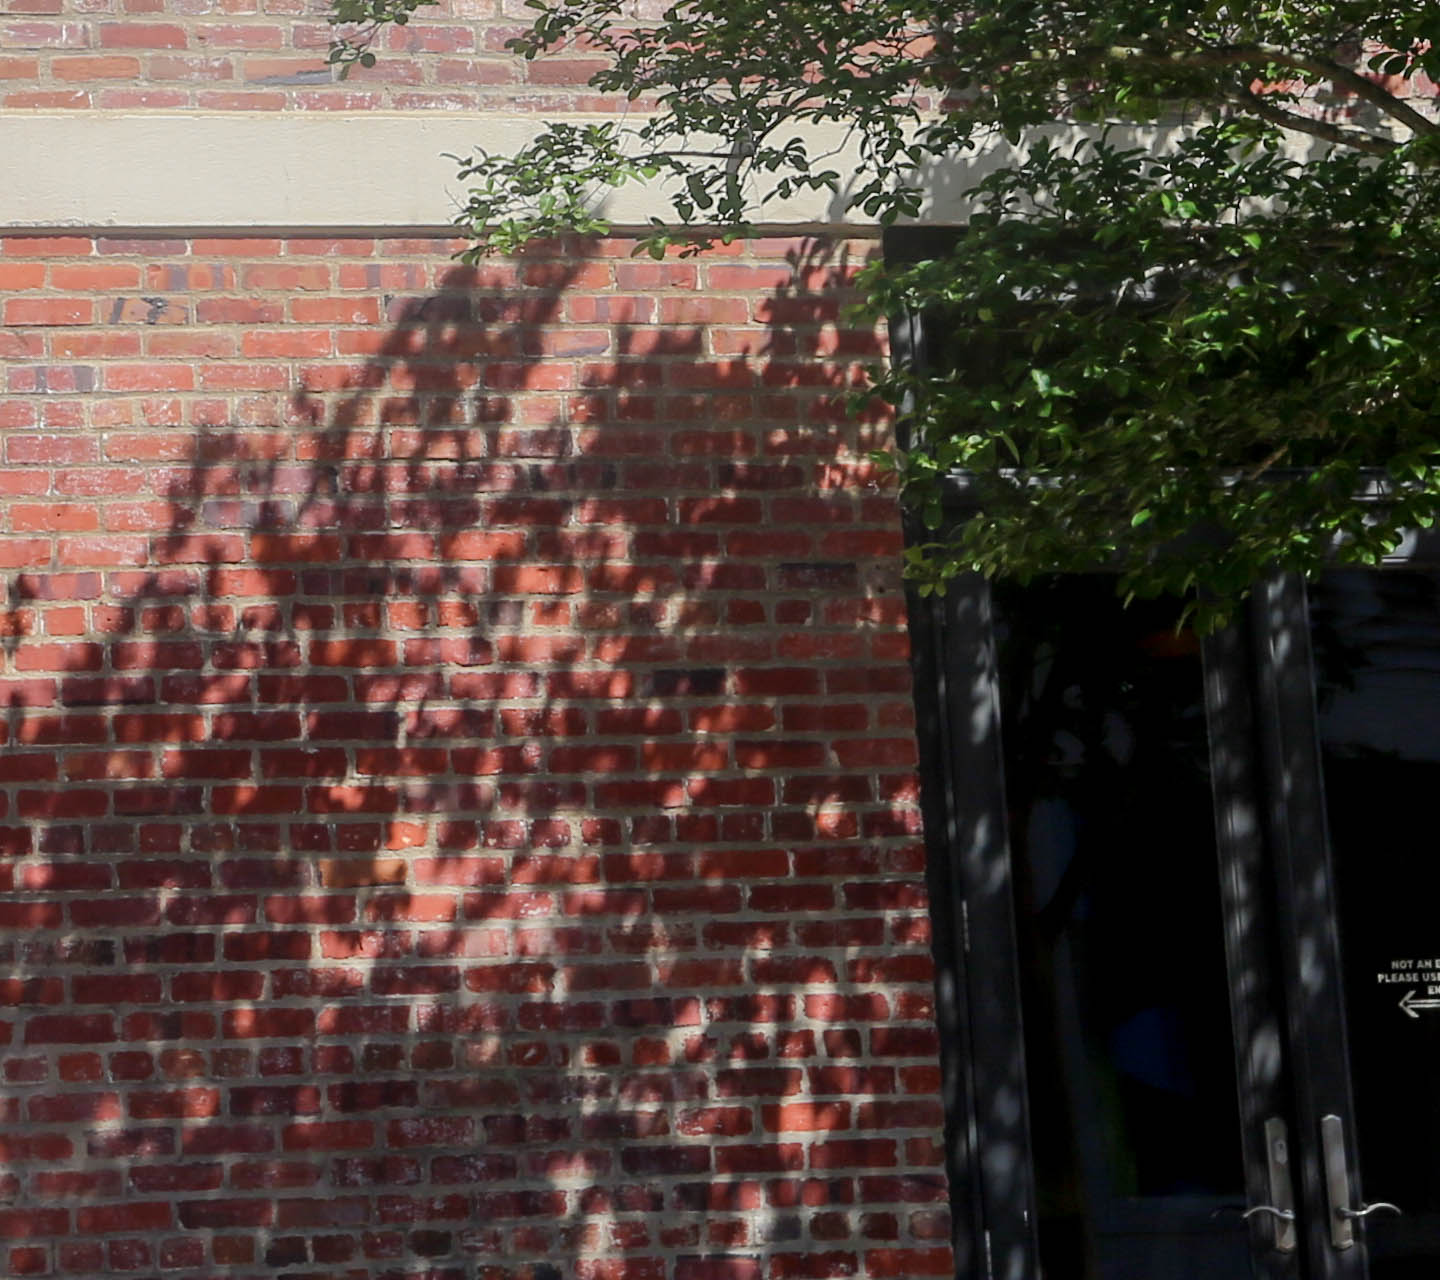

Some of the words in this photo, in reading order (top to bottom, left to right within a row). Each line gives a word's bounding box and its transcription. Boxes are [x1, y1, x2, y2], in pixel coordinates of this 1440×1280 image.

[1391, 959, 1413, 969] NOT
[1416, 959, 1433, 969] AN
[1377, 972, 1419, 983] PLEASE
